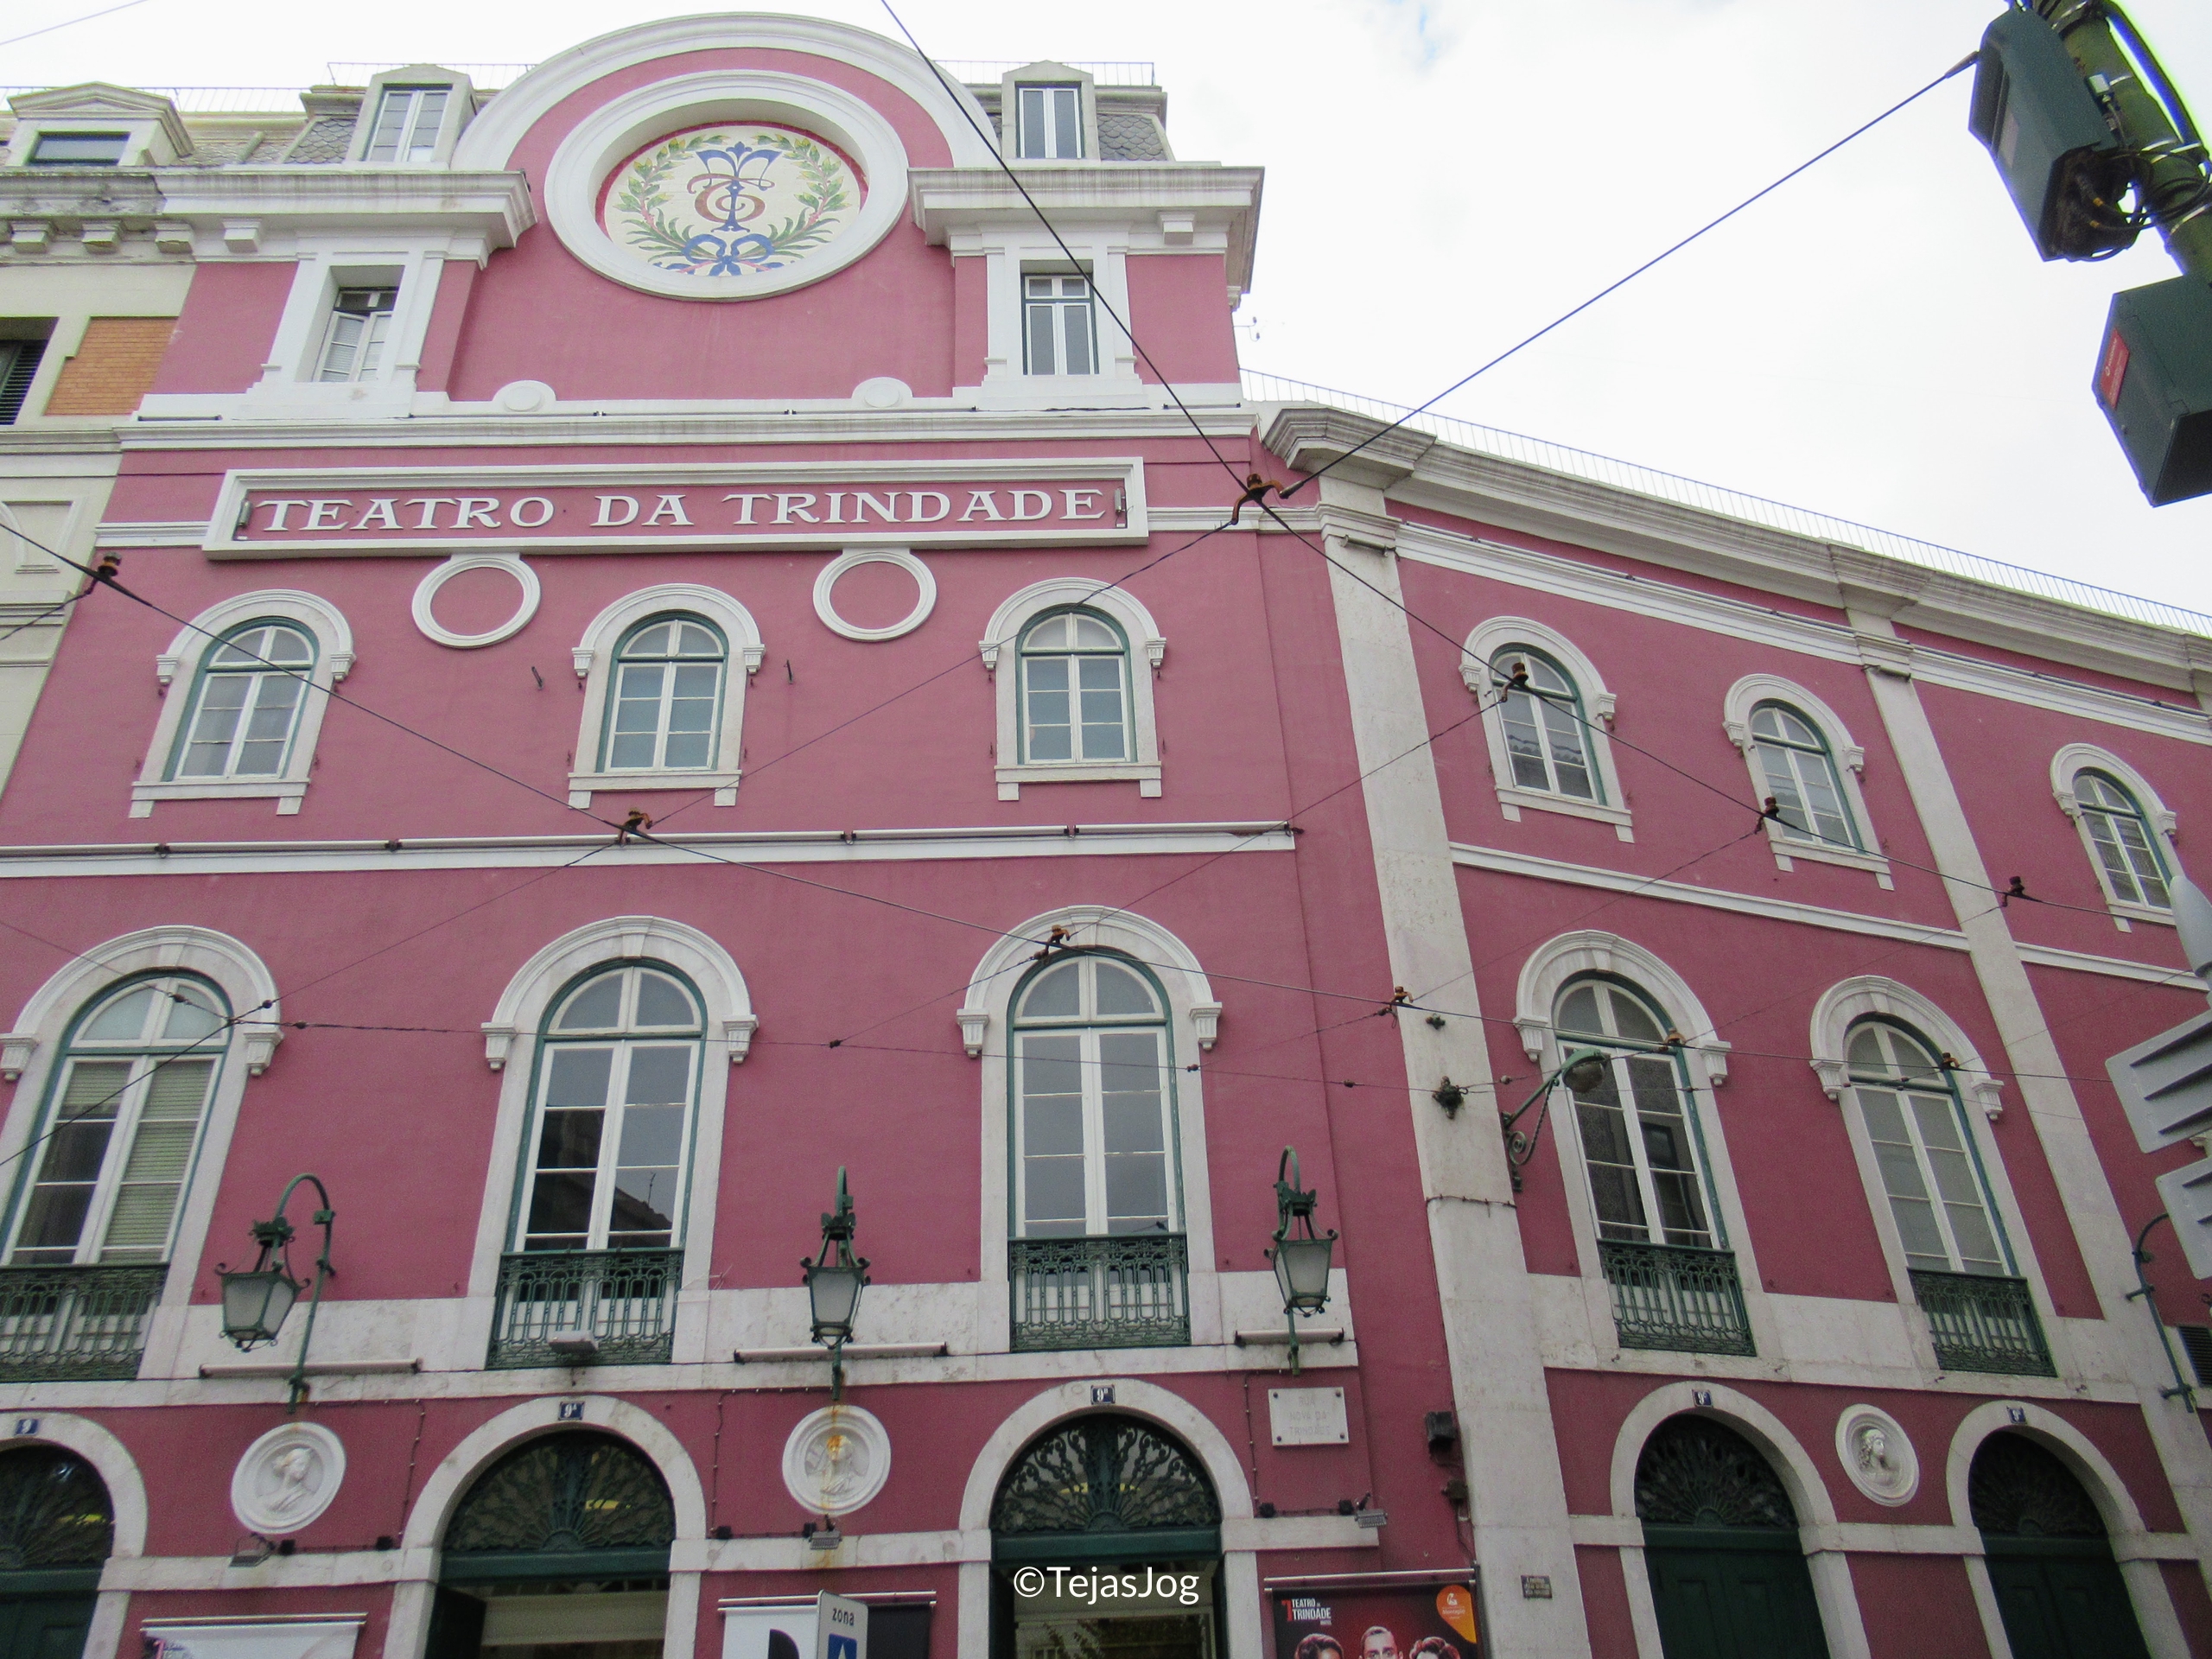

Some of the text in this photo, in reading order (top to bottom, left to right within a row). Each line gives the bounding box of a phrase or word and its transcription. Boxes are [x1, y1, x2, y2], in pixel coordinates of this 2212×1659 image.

[255, 488, 1106, 532] TEATRO DA TRINDADE
[1291, 1598, 1316, 1608] TEATRO
[832, 1608, 855, 1626] zona
[1292, 1607, 1332, 1620] TRINDADE
